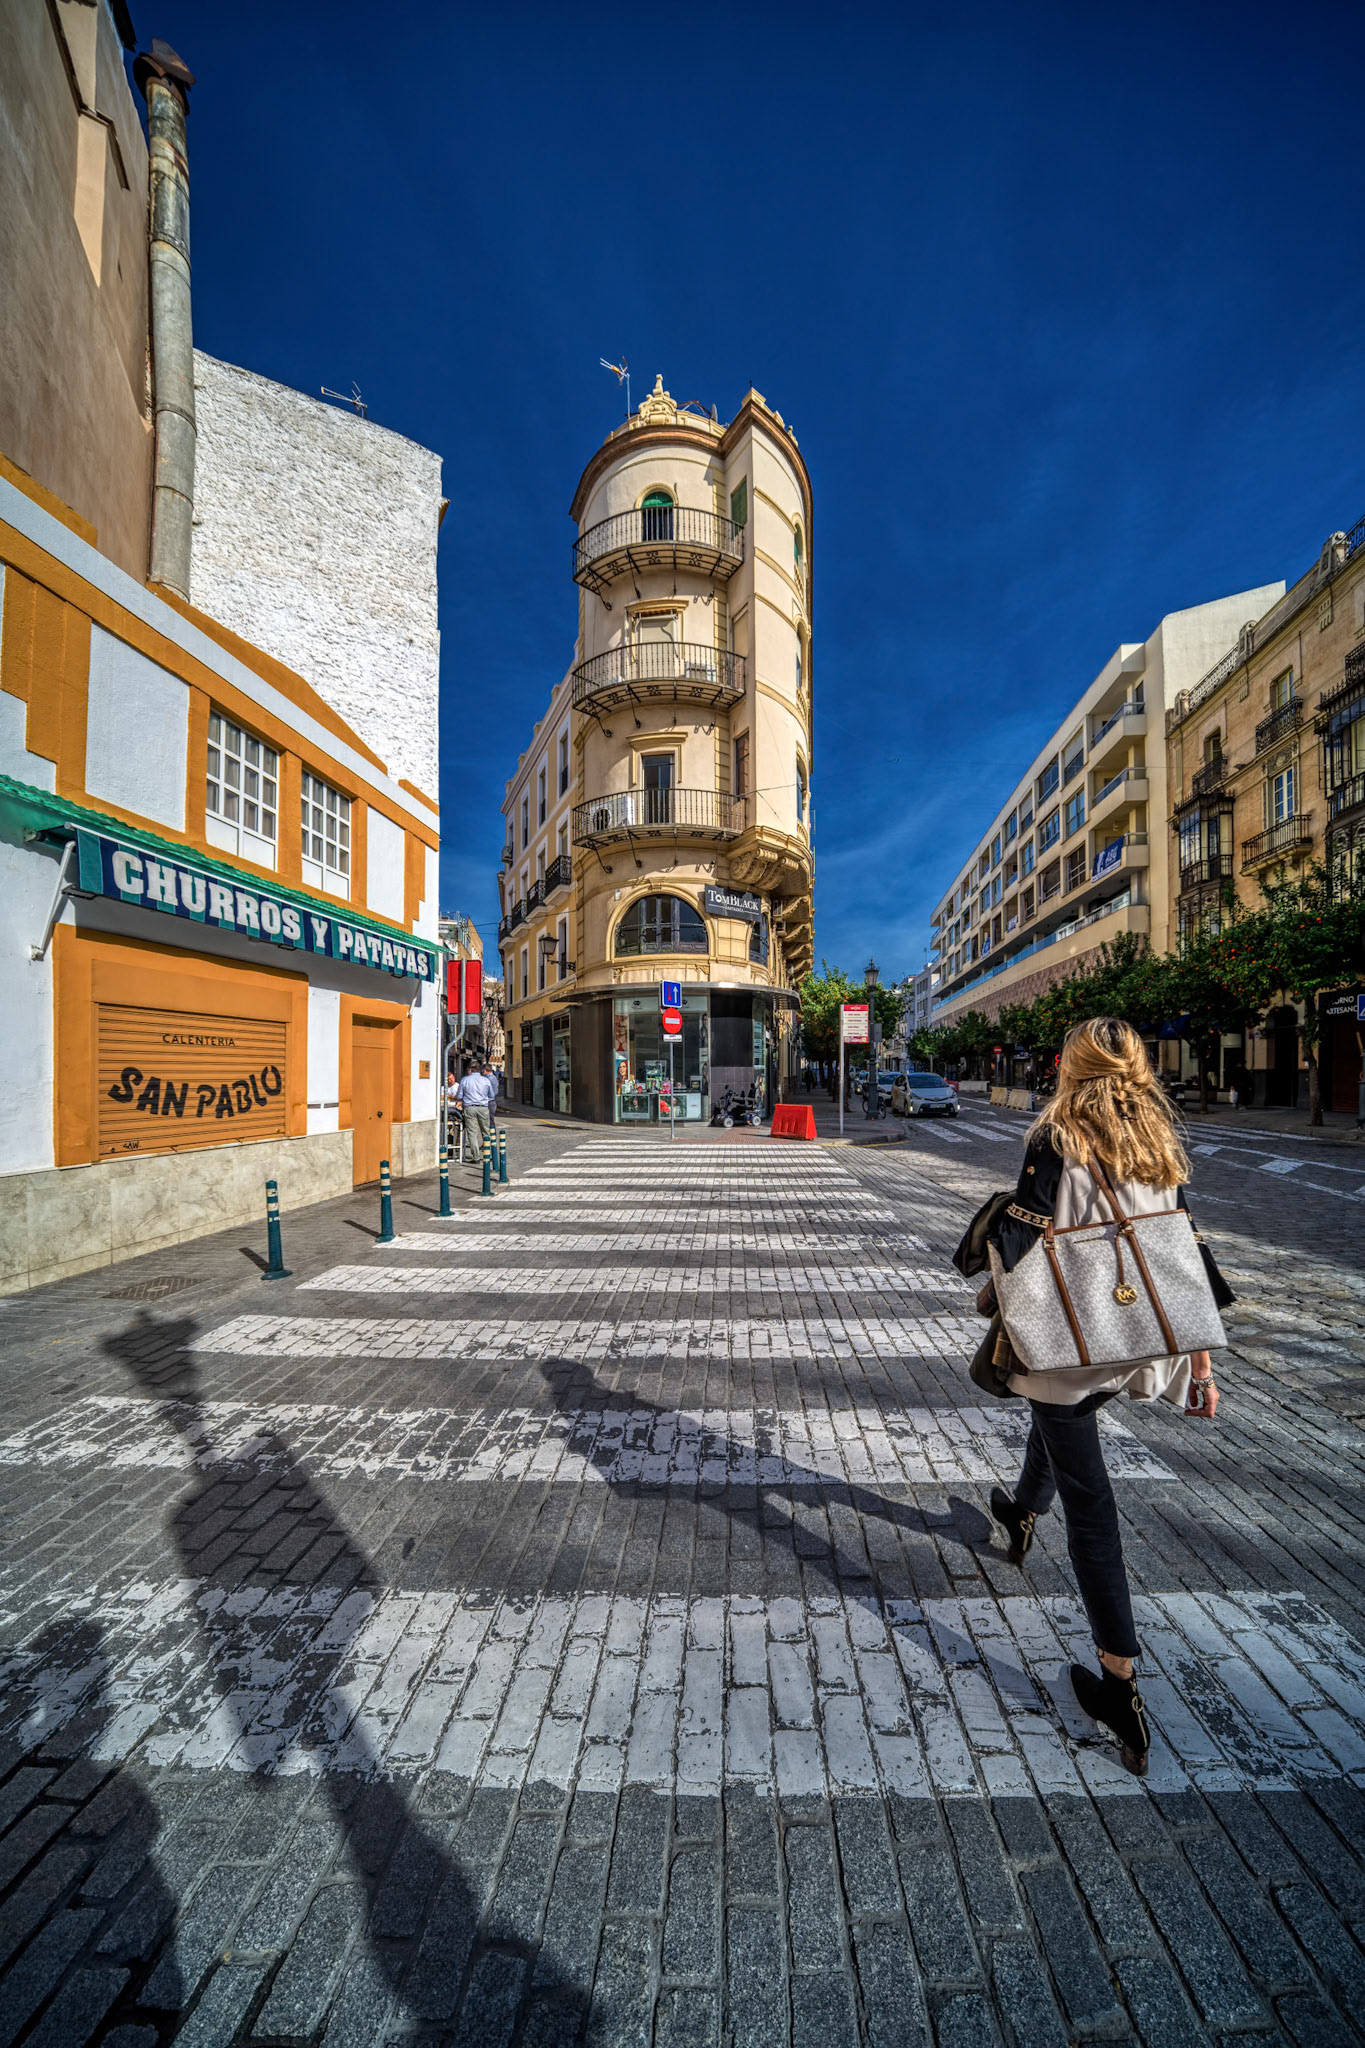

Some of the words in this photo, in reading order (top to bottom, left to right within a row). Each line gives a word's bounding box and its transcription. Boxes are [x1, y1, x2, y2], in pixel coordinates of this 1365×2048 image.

[112, 850, 301, 940] CHURROS
[311, 917, 328, 948] Y
[338, 926, 428, 976] PATATAS
[162, 1033, 235, 1047] CALENTERIA
[107, 1066, 189, 1118] SAN
[196, 1065, 282, 1119] PABLO
[1117, 1288, 1136, 1300] MK
